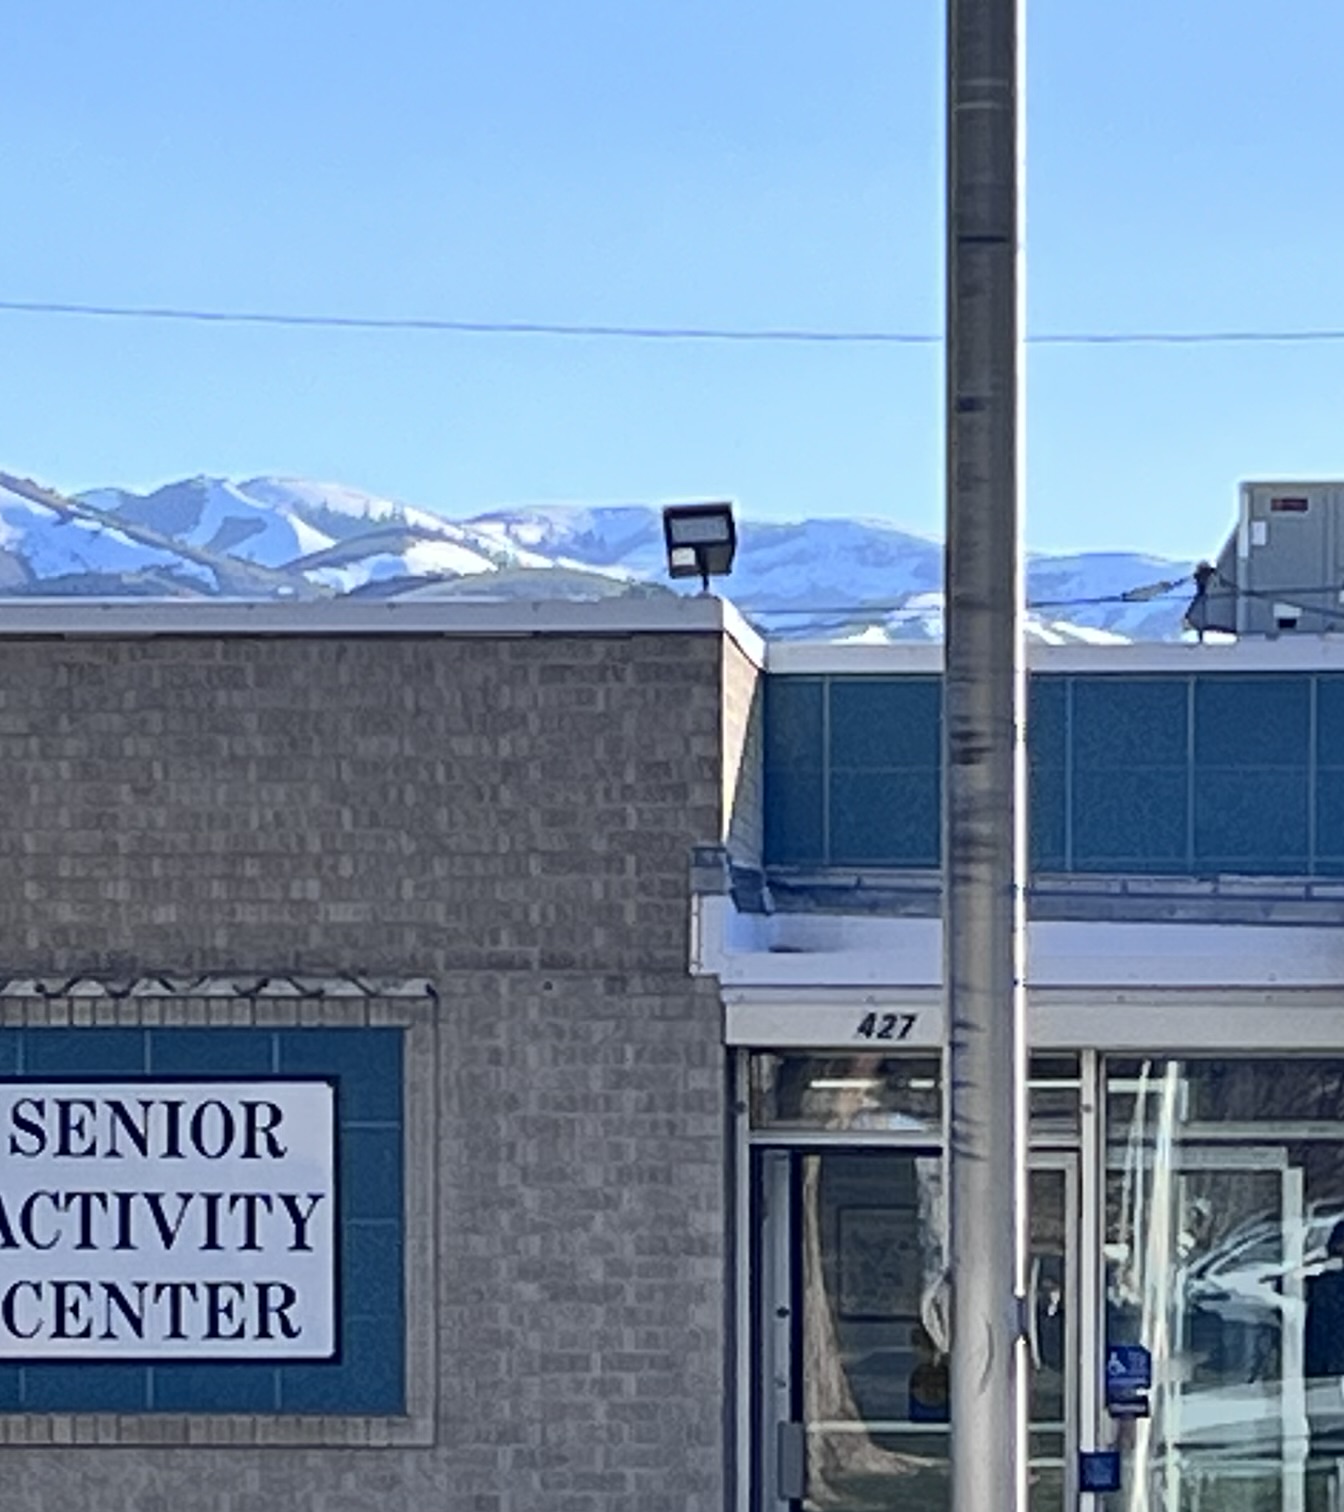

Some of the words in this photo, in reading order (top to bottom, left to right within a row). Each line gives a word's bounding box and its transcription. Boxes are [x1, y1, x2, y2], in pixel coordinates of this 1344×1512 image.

[856, 1012, 918, 1040] 427
[8, 1097, 288, 1160] SENIOR
[1, 1280, 303, 1341] CENTER
